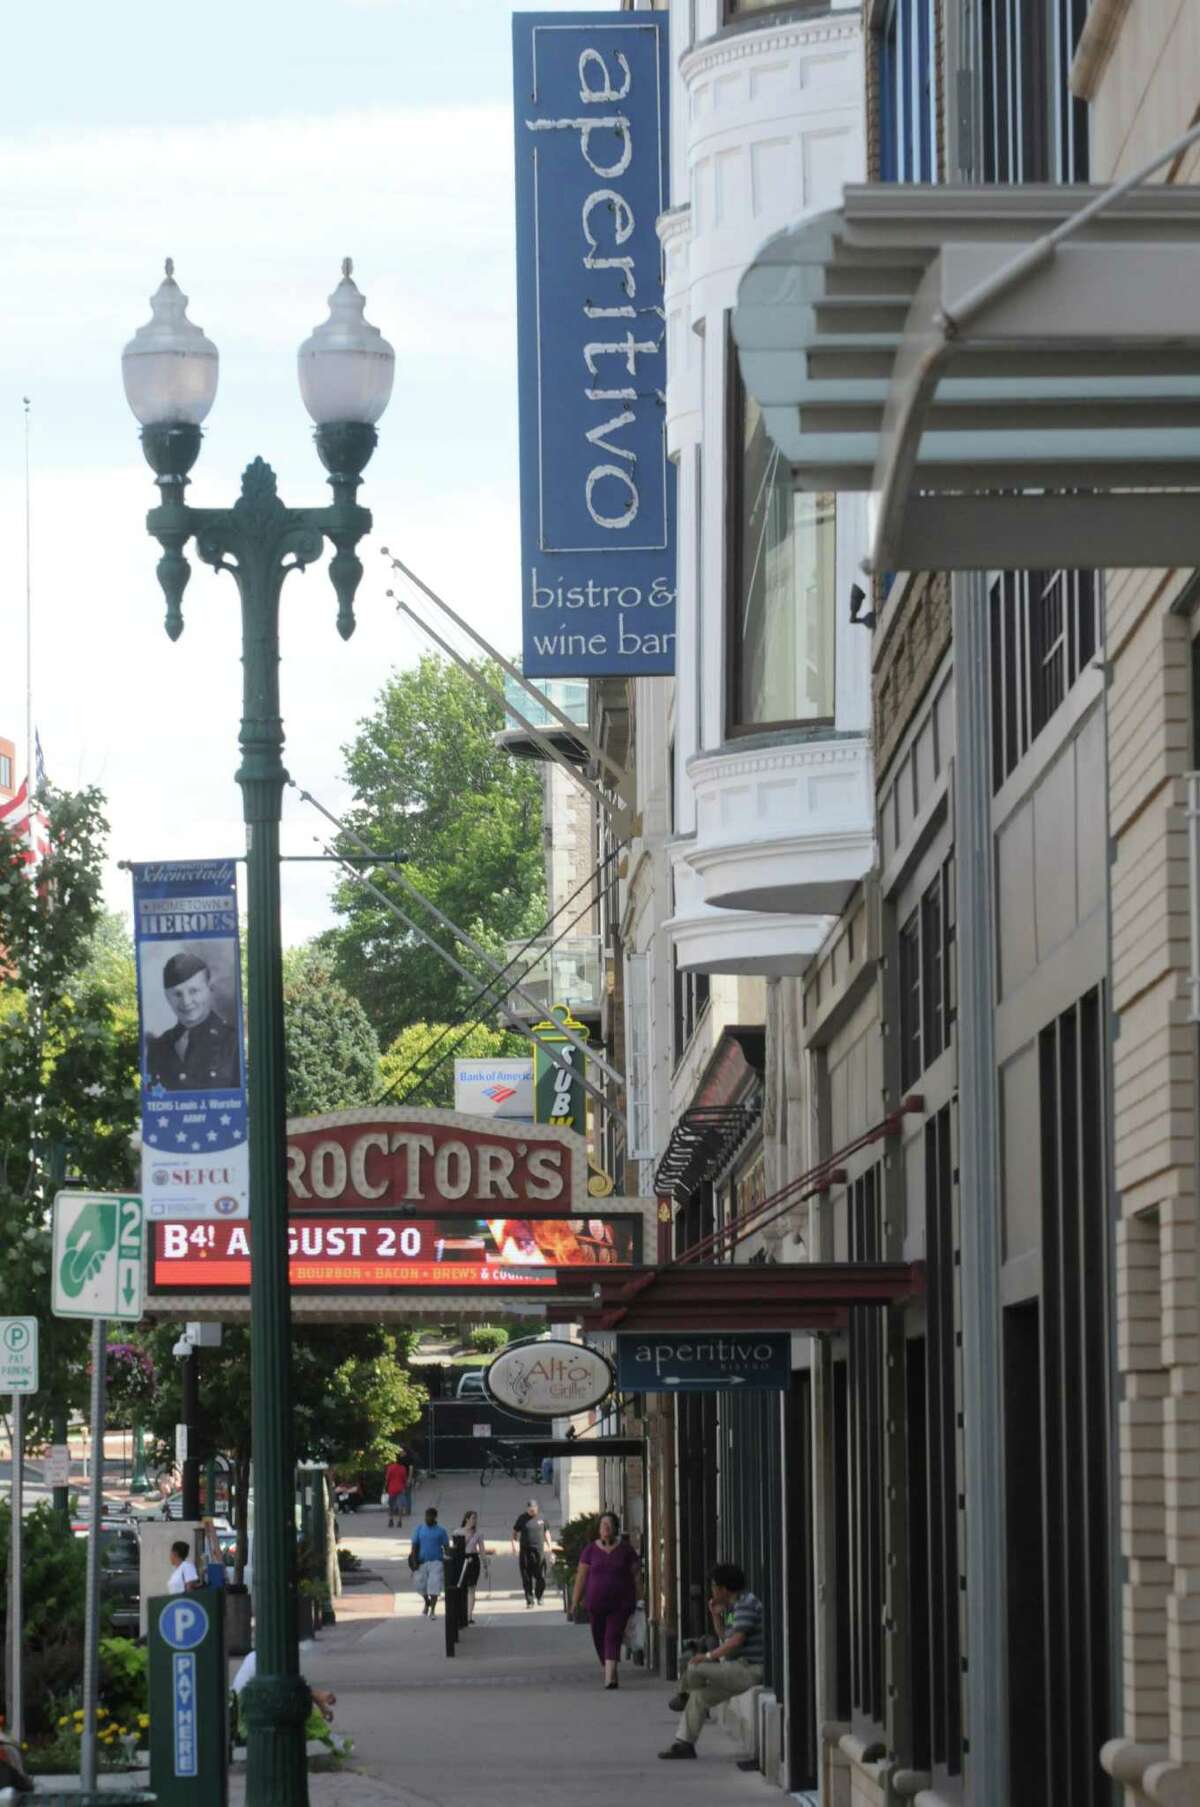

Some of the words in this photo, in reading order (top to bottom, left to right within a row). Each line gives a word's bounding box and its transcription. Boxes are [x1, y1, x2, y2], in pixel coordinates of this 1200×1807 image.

[526, 47, 657, 529] aperitivo
[531, 567, 642, 608] bistro
[648, 577, 677, 607] &
[533, 623, 608, 655] wine
[617, 612, 676, 655] bar
[142, 913, 235, 933] HEROES
[287, 1131, 564, 1201] ROCTOR'S
[121, 1201, 141, 1246] 2
[376, 1227, 421, 1256] 20
[376, 1267, 418, 1280] BACON
[11, 1327, 24, 1346] P
[524, 1357, 590, 1382] Alto
[635, 1338, 773, 1376] aperitivo
[174, 1607, 196, 1642] P
[177, 1657, 192, 1705] PAY
[178, 1709, 193, 1771] HERE
